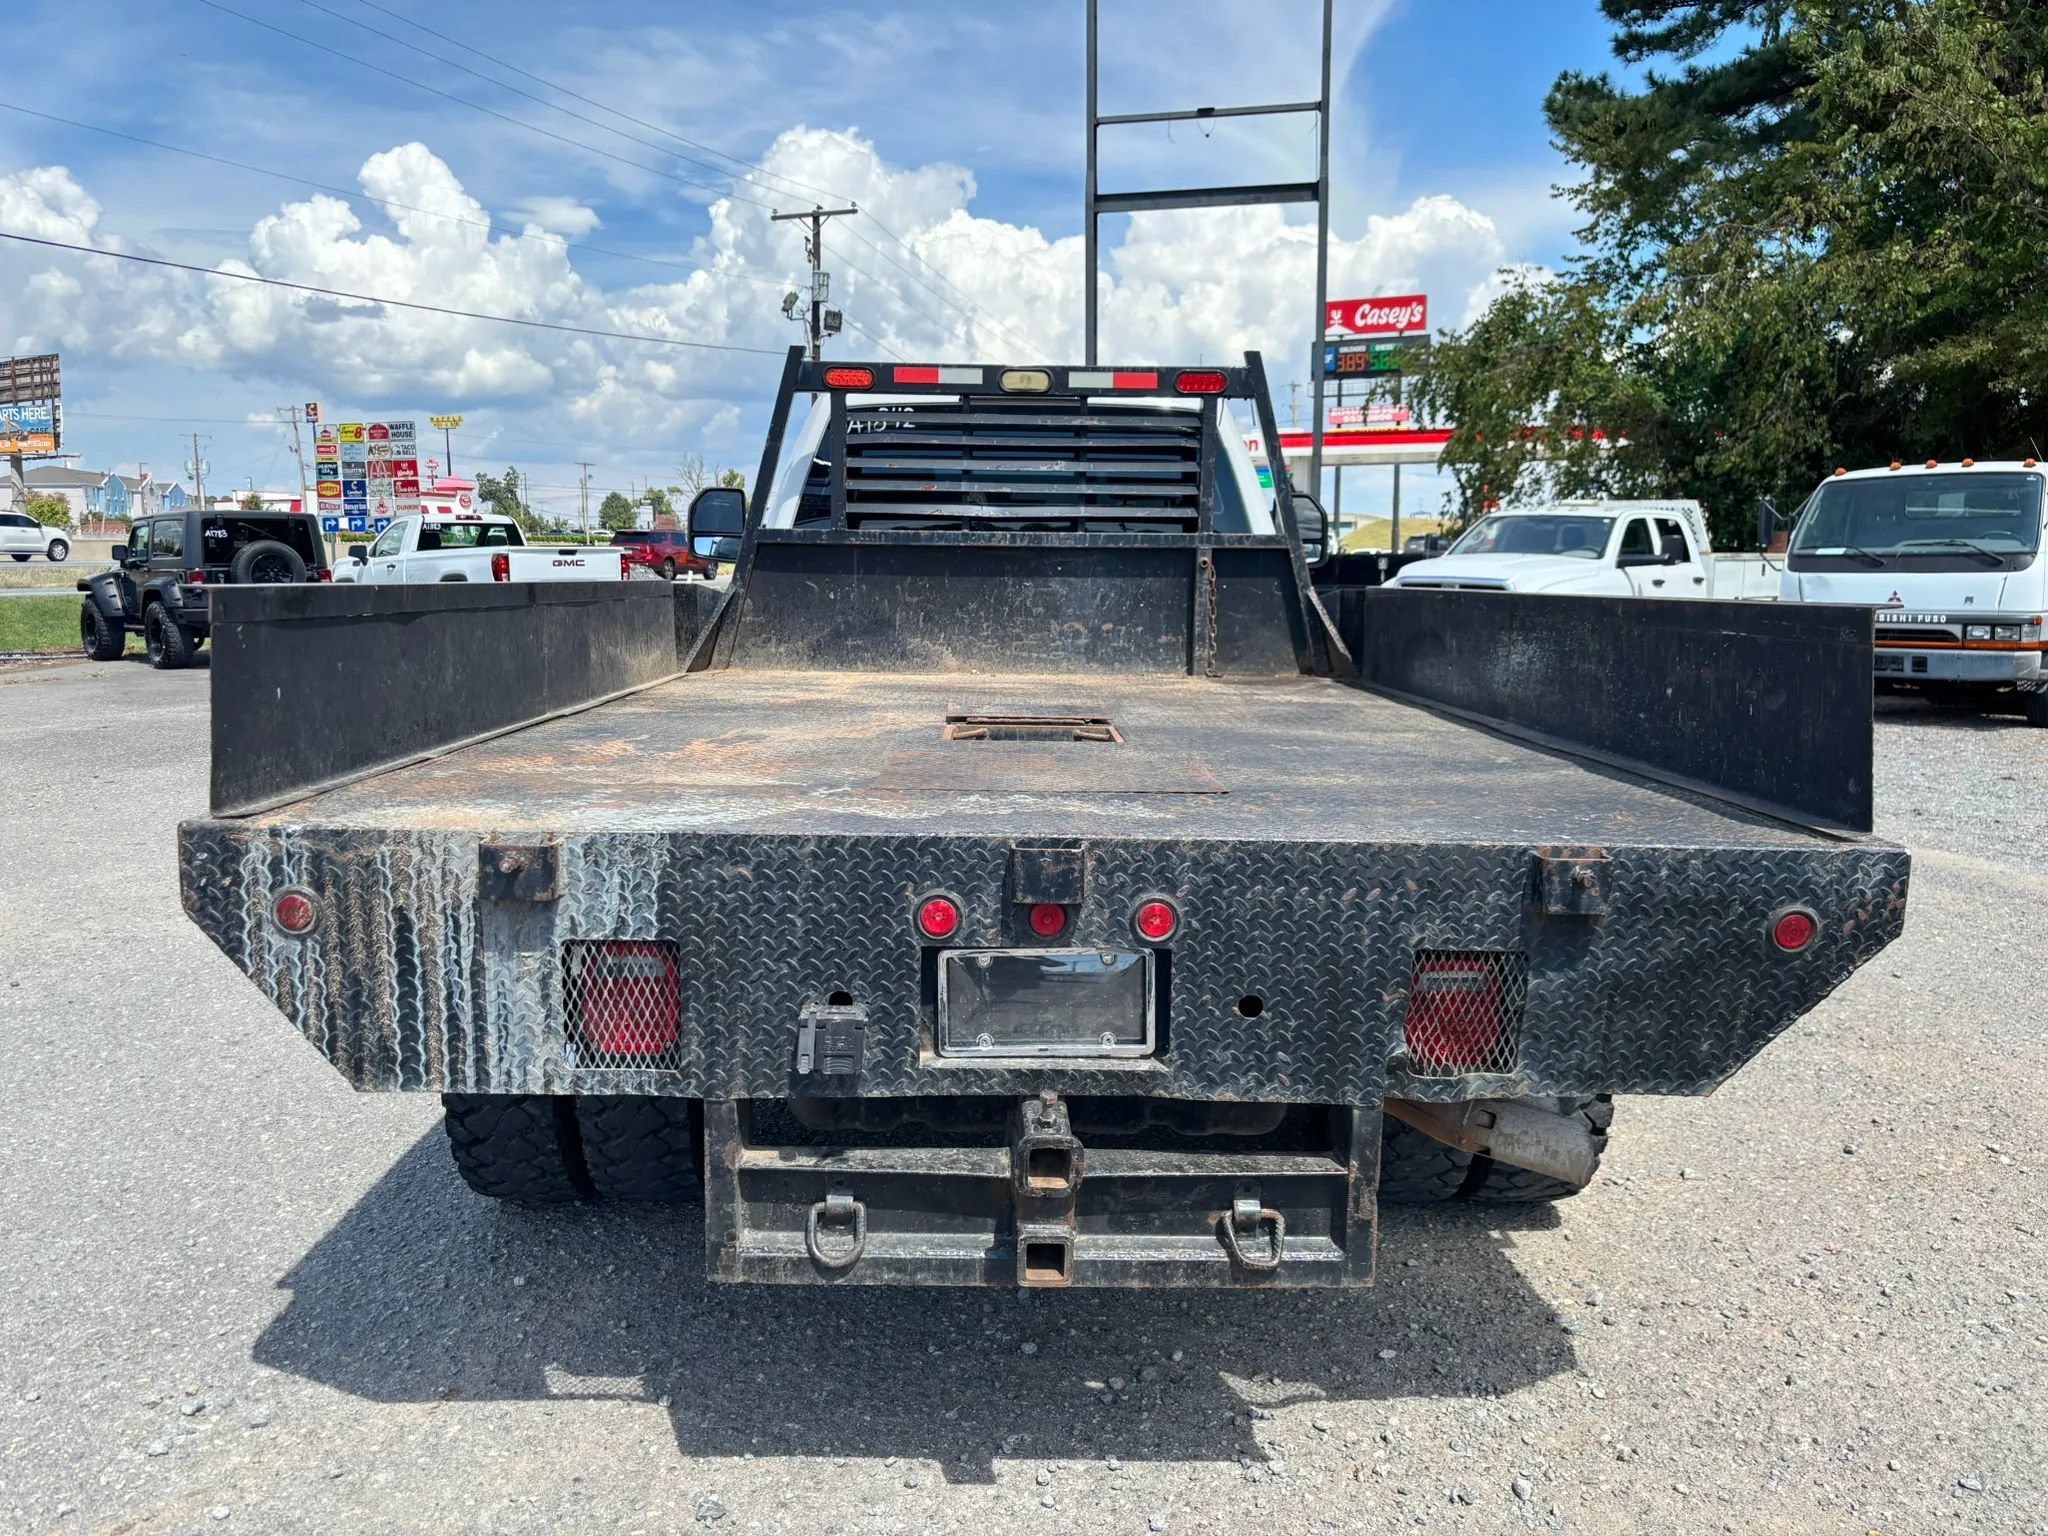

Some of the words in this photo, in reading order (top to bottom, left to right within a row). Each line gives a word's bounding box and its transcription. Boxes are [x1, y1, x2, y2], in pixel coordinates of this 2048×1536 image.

[1355, 302, 1423, 329] Casey's
[21, 407, 50, 420] HERE.
[354, 426, 363, 439] 8
[552, 559, 586, 567] GMC
[1874, 614, 1912, 623] BISHI
[1917, 614, 1947, 623] FUSO
